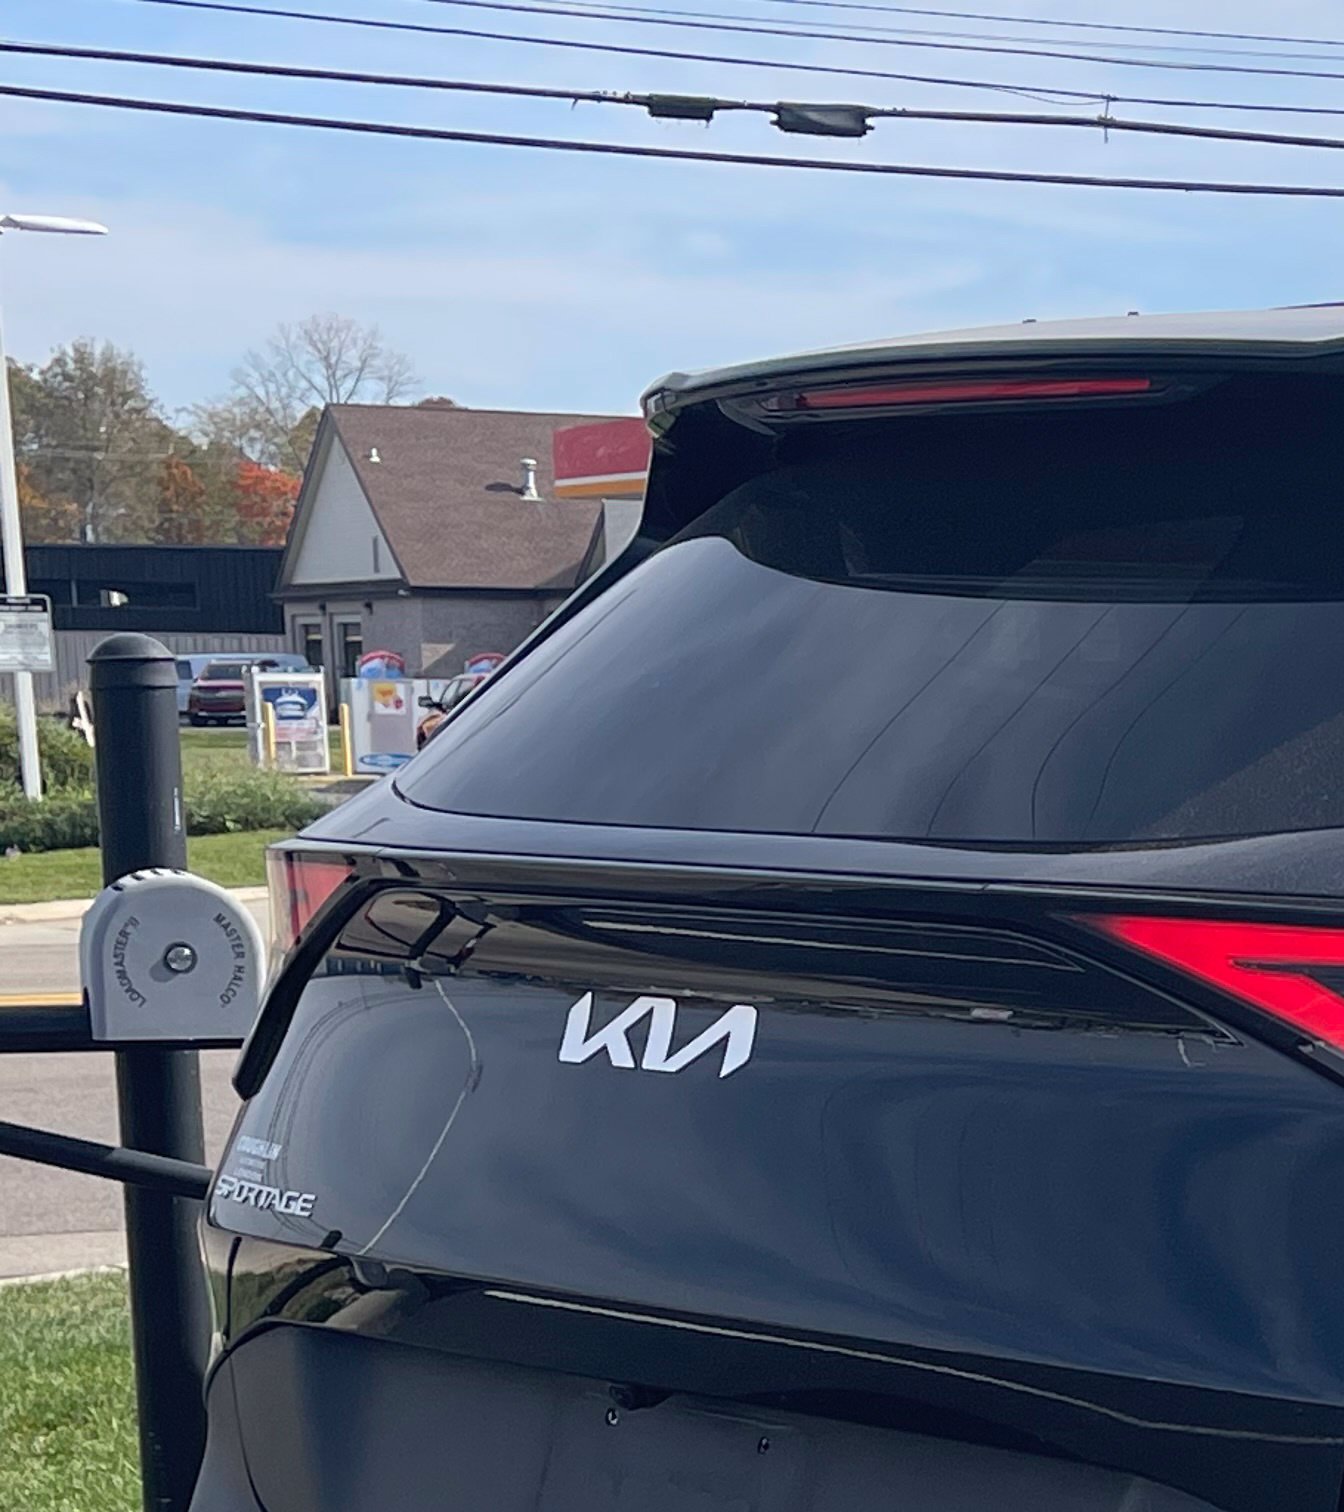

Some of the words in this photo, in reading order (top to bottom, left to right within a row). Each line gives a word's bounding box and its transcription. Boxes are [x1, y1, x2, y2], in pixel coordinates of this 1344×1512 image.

[213, 912, 246, 961] MASTER
[558, 990, 758, 1079] KIA
[214, 1174, 316, 1217] SPORTAGE
